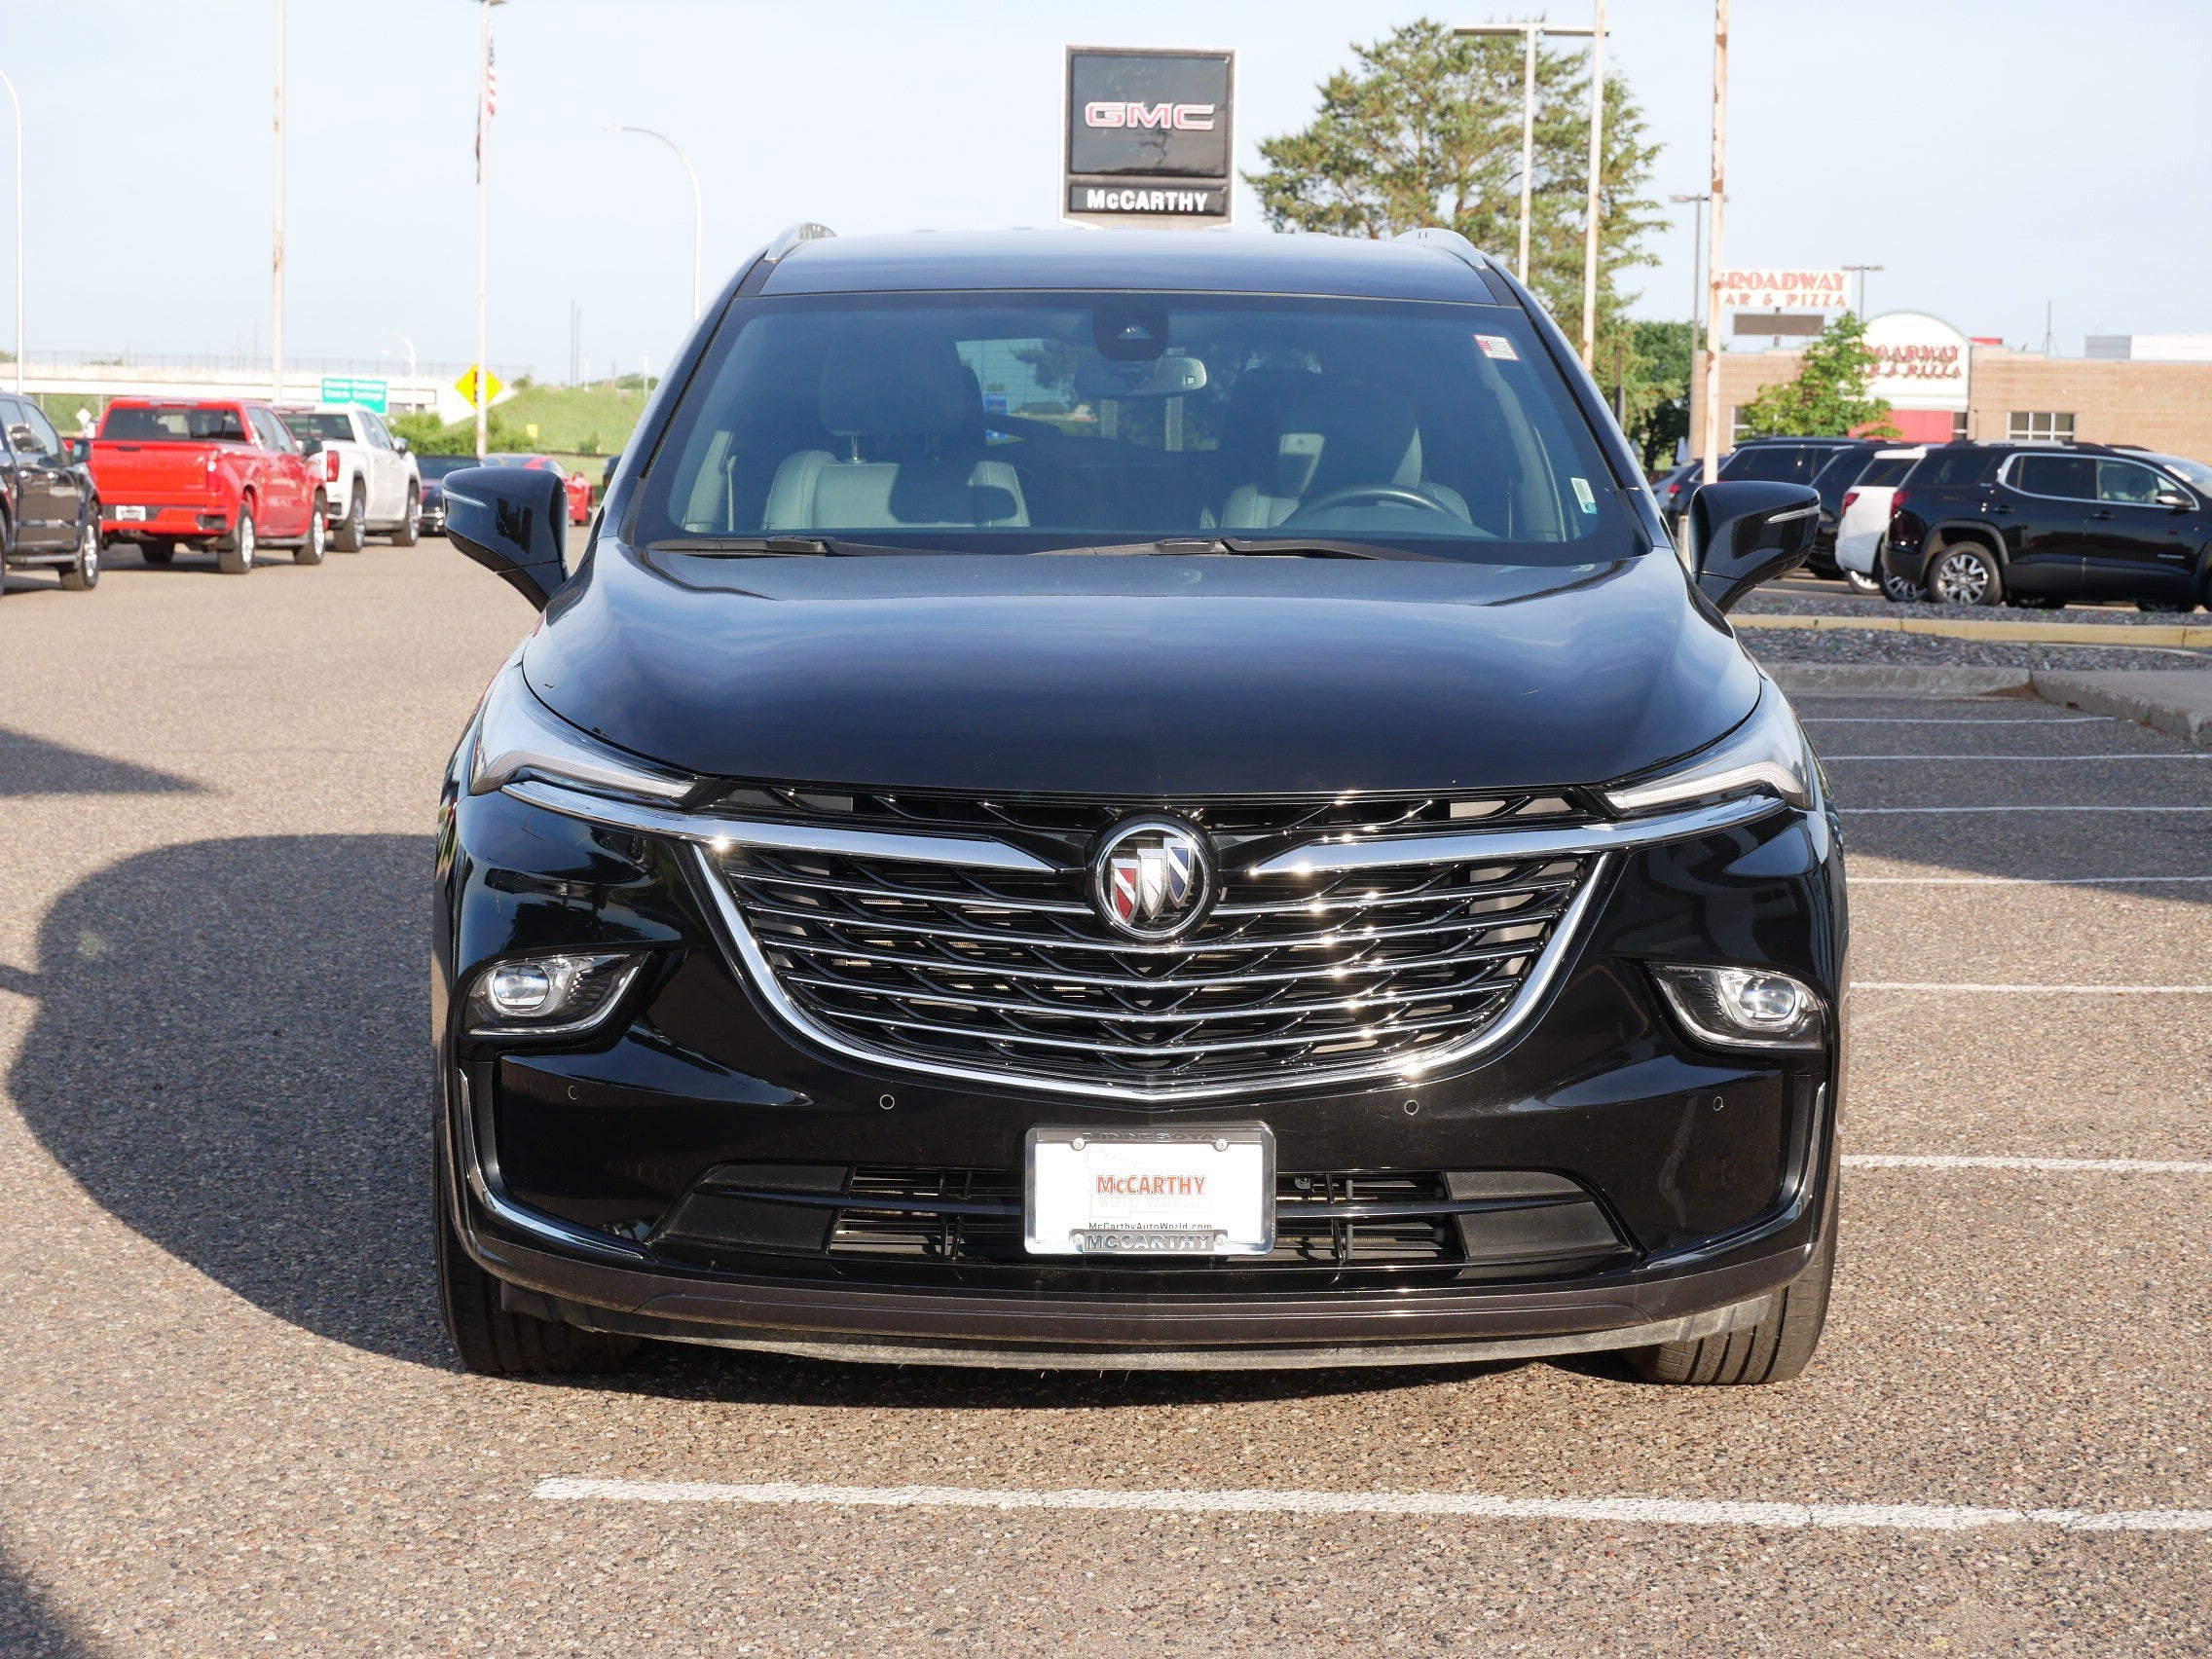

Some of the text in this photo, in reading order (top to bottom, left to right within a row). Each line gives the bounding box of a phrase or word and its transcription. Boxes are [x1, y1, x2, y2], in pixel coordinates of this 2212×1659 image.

[1085, 101, 1215, 130] GMC
[1087, 189, 1208, 211] McCARTHY
[1724, 293, 1847, 307] AR & PIZZA
[1096, 1175, 1206, 1195] McCARTHY
